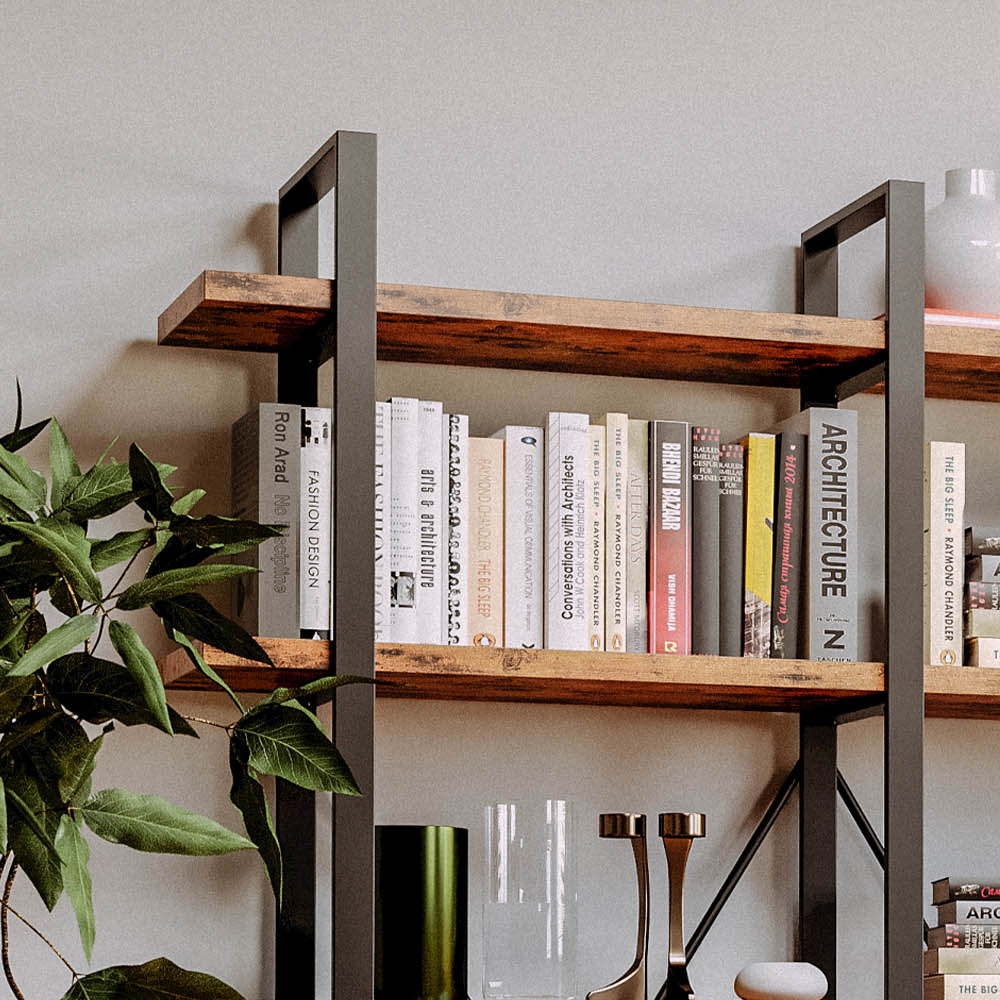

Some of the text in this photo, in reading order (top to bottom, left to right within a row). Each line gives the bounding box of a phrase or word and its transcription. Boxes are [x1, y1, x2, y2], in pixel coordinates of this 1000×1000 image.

[275, 412, 289, 483] Ron Arad
[662, 442, 681, 531] BHENDI BAZAAR
[308, 471, 319, 588] FASHION DESIGN
[421, 469, 437, 588] arts architecture
[562, 455, 574, 620] Conversations with Architects
[630, 472, 642, 563] AFTER DAYS
[822, 423, 848, 597] ARCHITECTURE
[945, 456, 954, 641] THE BIG SLEEP RAYMOND CHANDLER
[824, 629, 845, 649] Z
[959, 986, 977, 994] THE
[981, 985, 998, 994] BIG
